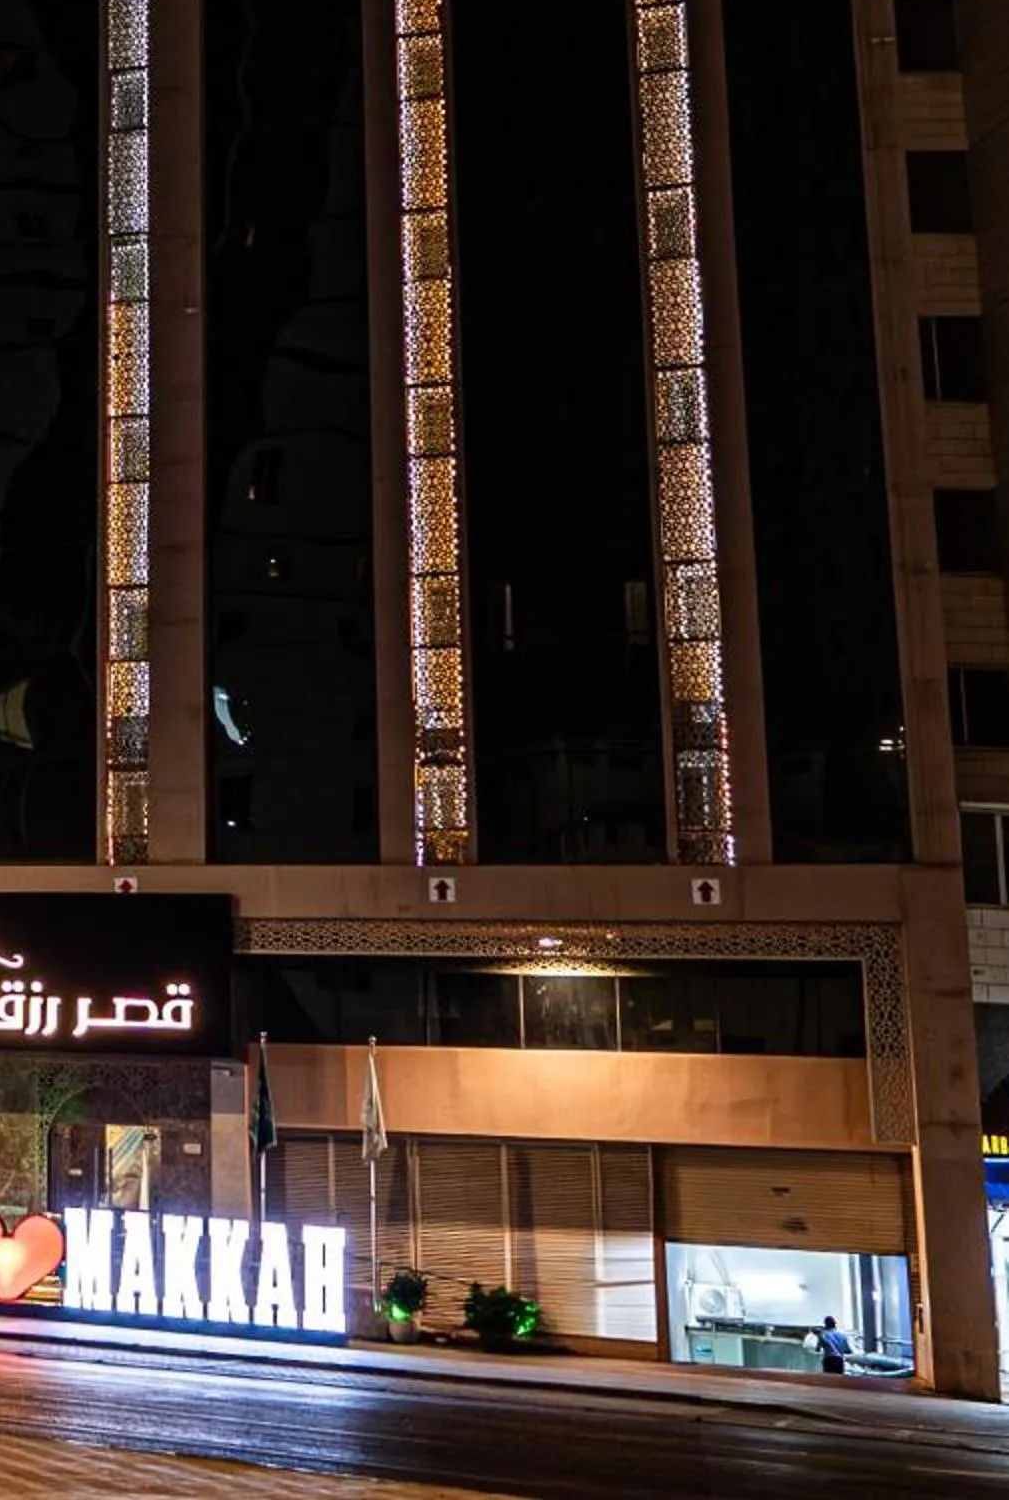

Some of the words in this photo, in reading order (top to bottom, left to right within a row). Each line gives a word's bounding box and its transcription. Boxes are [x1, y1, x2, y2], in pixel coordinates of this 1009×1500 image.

[72, 982, 194, 1037] قصر
[981, 1134, 1009, 1155] ARB
[63, 1206, 346, 1334] MAKKAH
